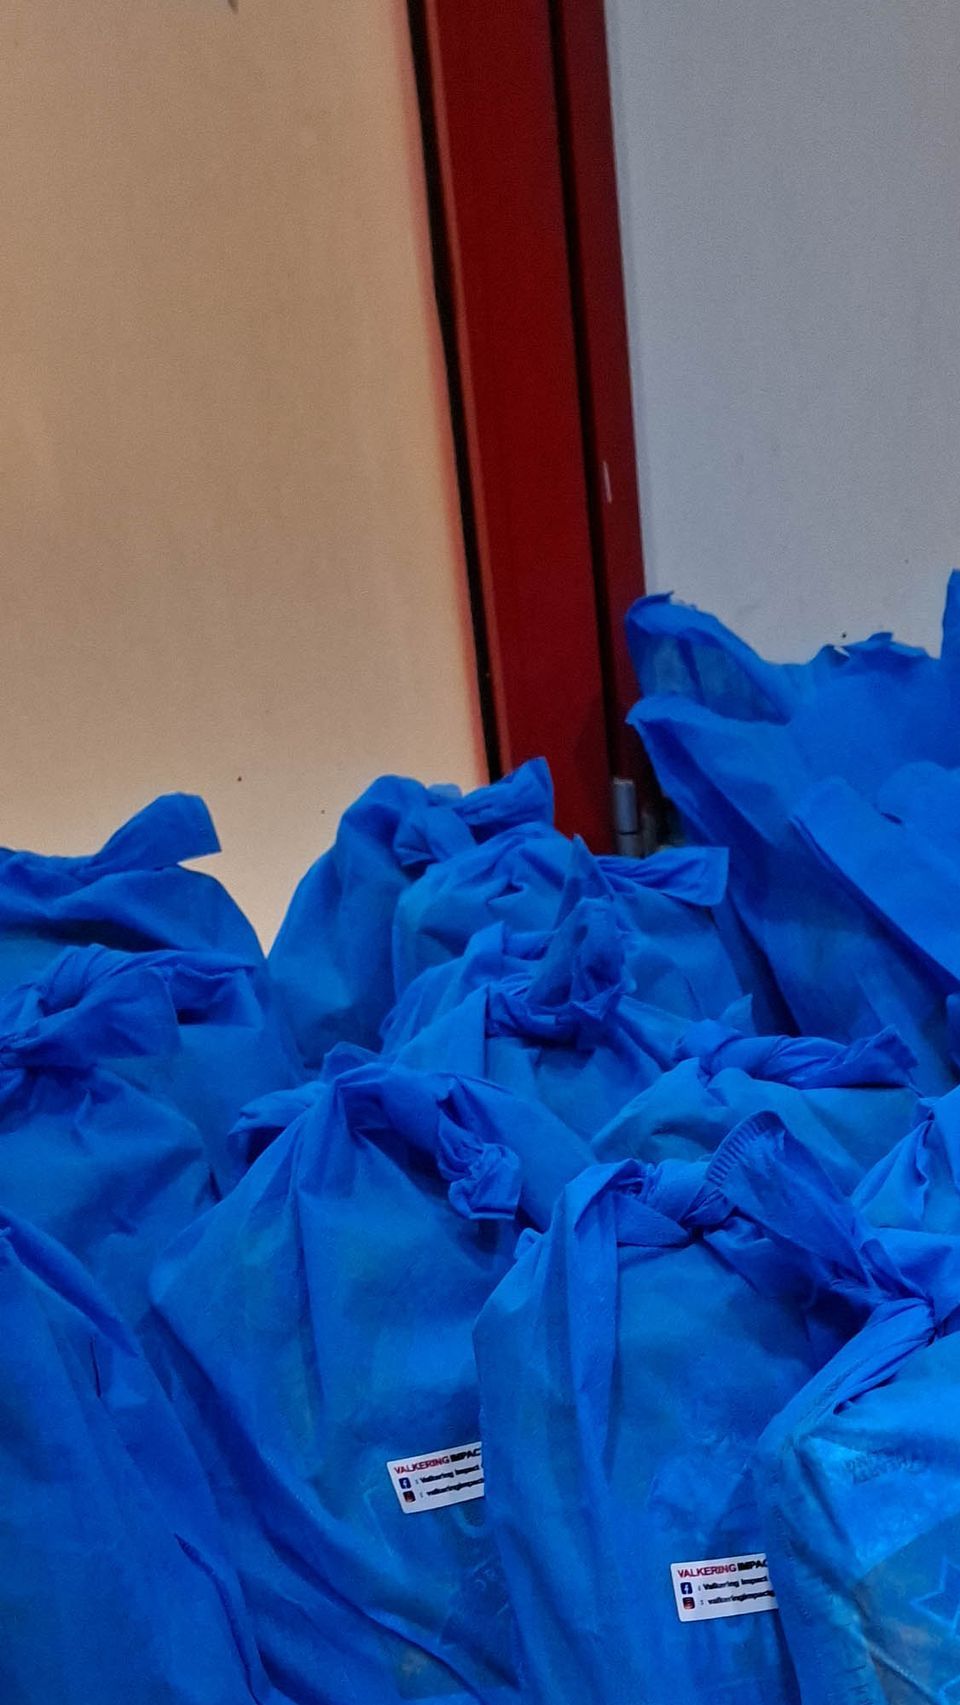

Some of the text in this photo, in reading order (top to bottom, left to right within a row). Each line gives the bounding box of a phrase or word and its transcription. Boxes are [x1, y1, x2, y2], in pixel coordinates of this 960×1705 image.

[394, 1448, 481, 1474] VALKERING IMPAC
[677, 1559, 767, 1579] VALKERING IMPAC
